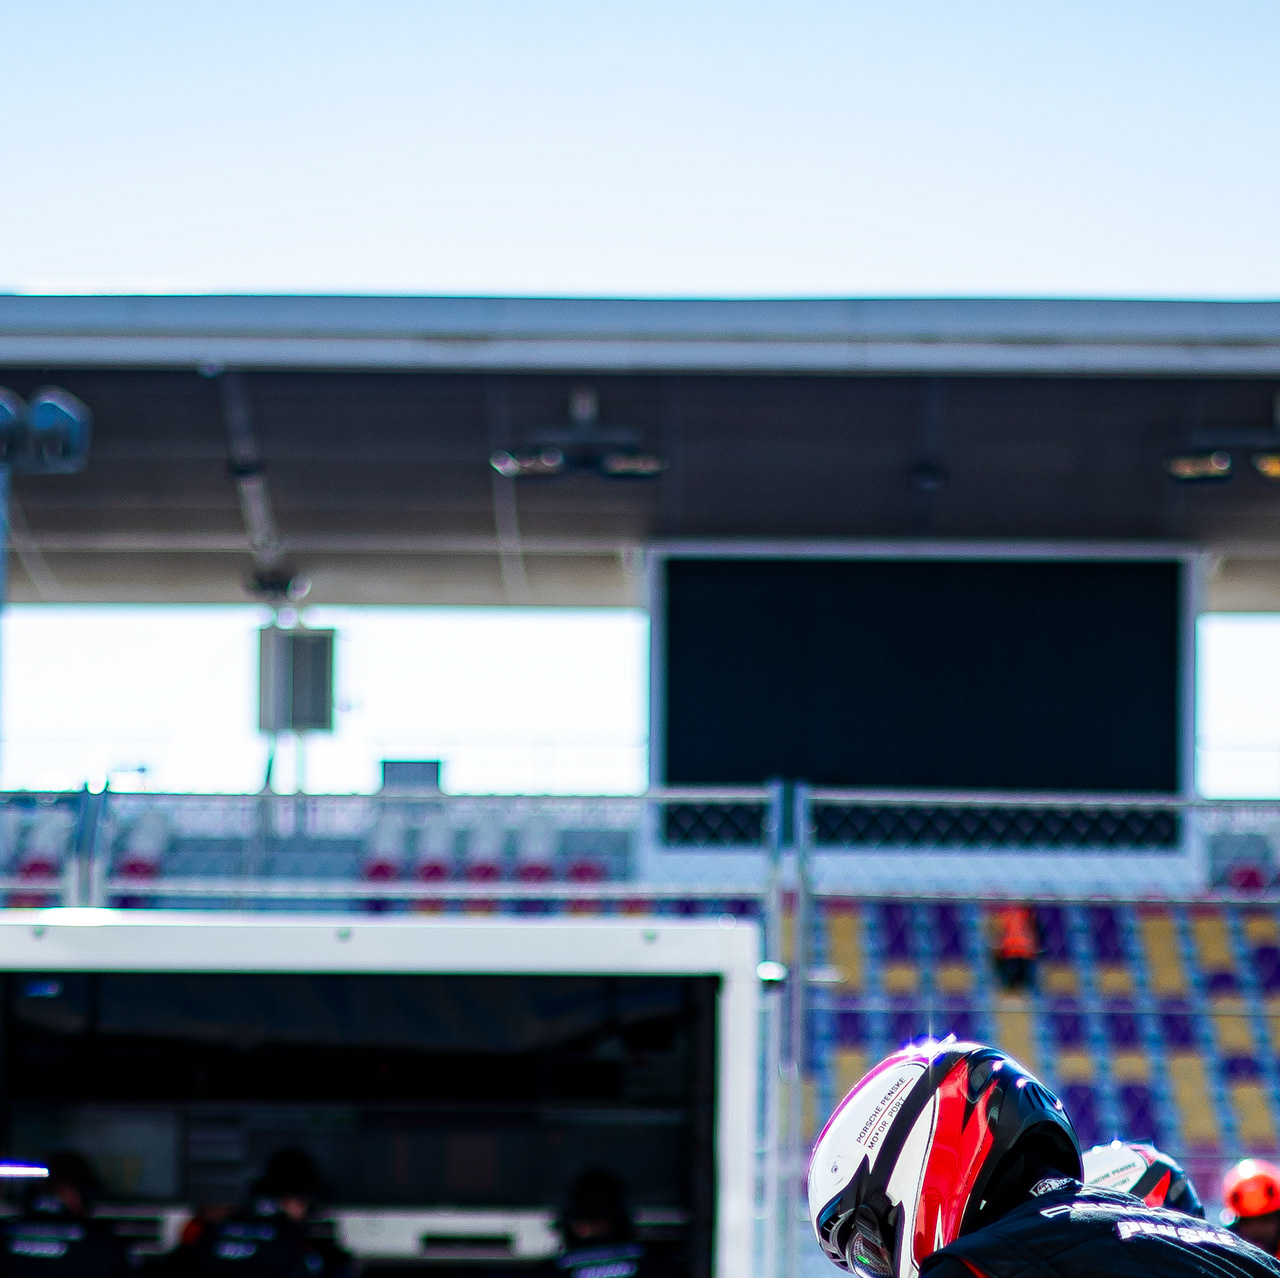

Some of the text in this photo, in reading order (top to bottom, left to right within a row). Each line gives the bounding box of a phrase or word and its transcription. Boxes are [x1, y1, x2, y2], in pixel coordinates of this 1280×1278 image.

[856, 1077, 907, 1144] PORSCHE PENSKE
[867, 1097, 906, 1150] MOORPORT
[1117, 1221, 1238, 1247] PENSKE
